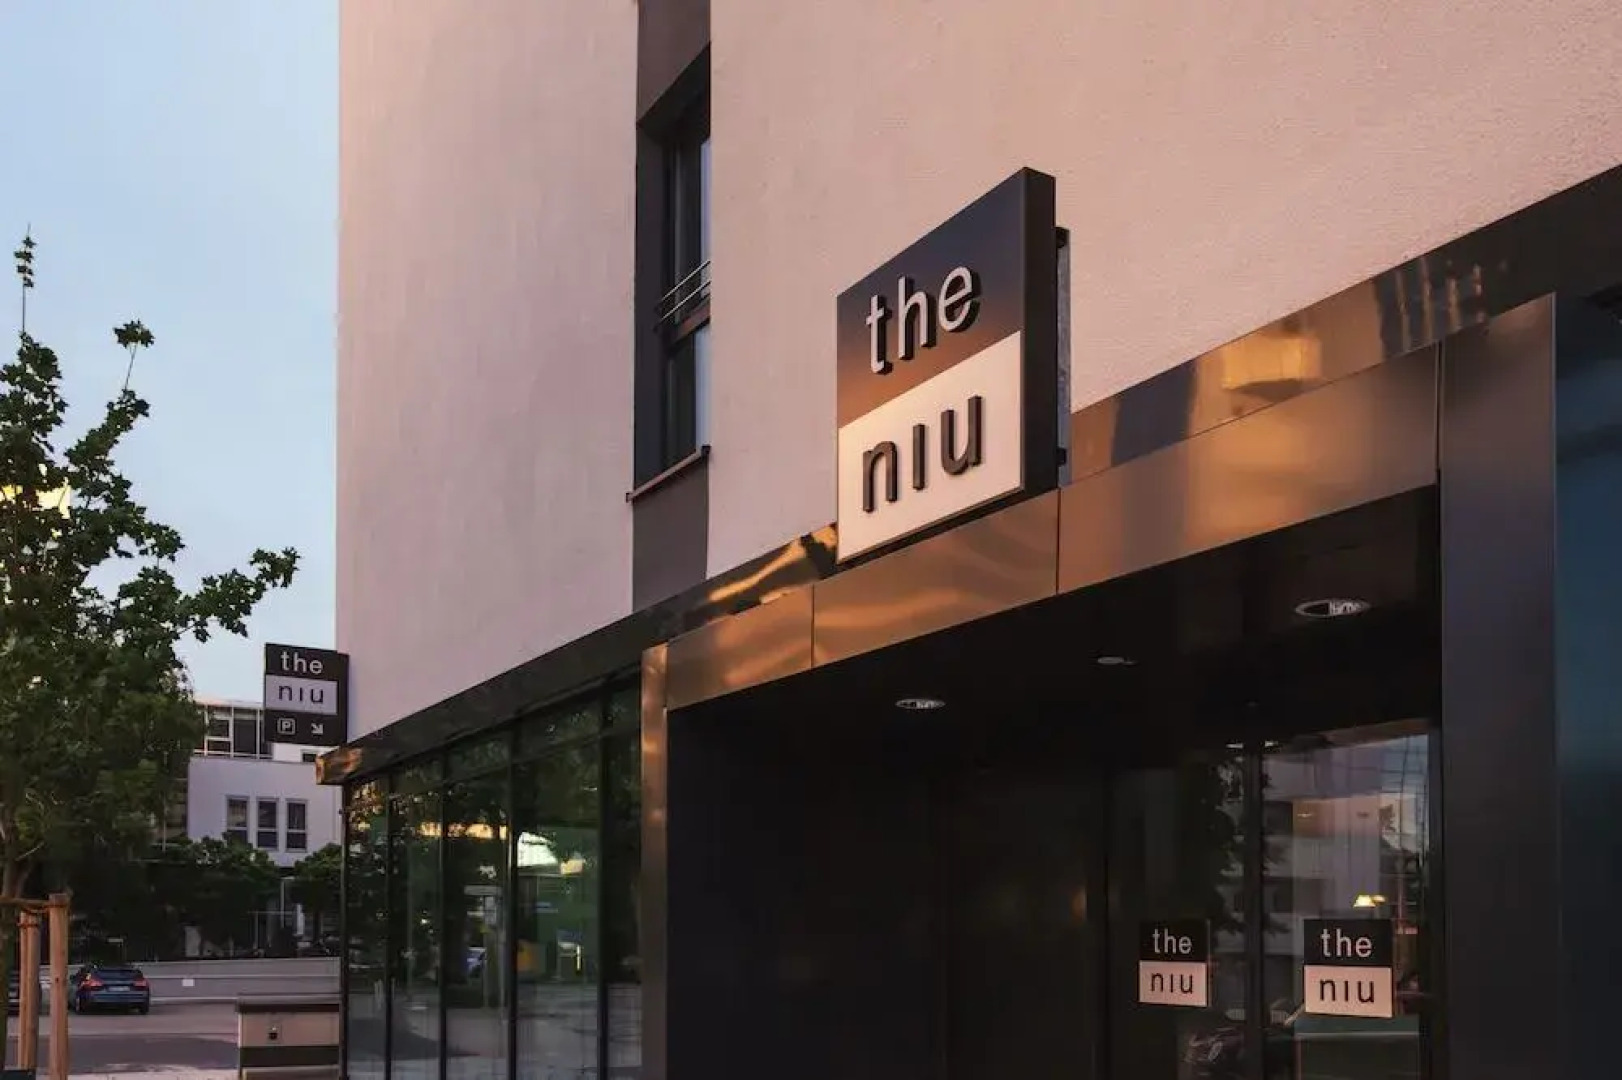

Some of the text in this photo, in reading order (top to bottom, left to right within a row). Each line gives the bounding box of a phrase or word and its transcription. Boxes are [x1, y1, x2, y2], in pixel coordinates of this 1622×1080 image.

[866, 266, 979, 374] the
[281, 651, 324, 674] the
[1152, 928, 1192, 954] the
[1320, 928, 1372, 958] the
